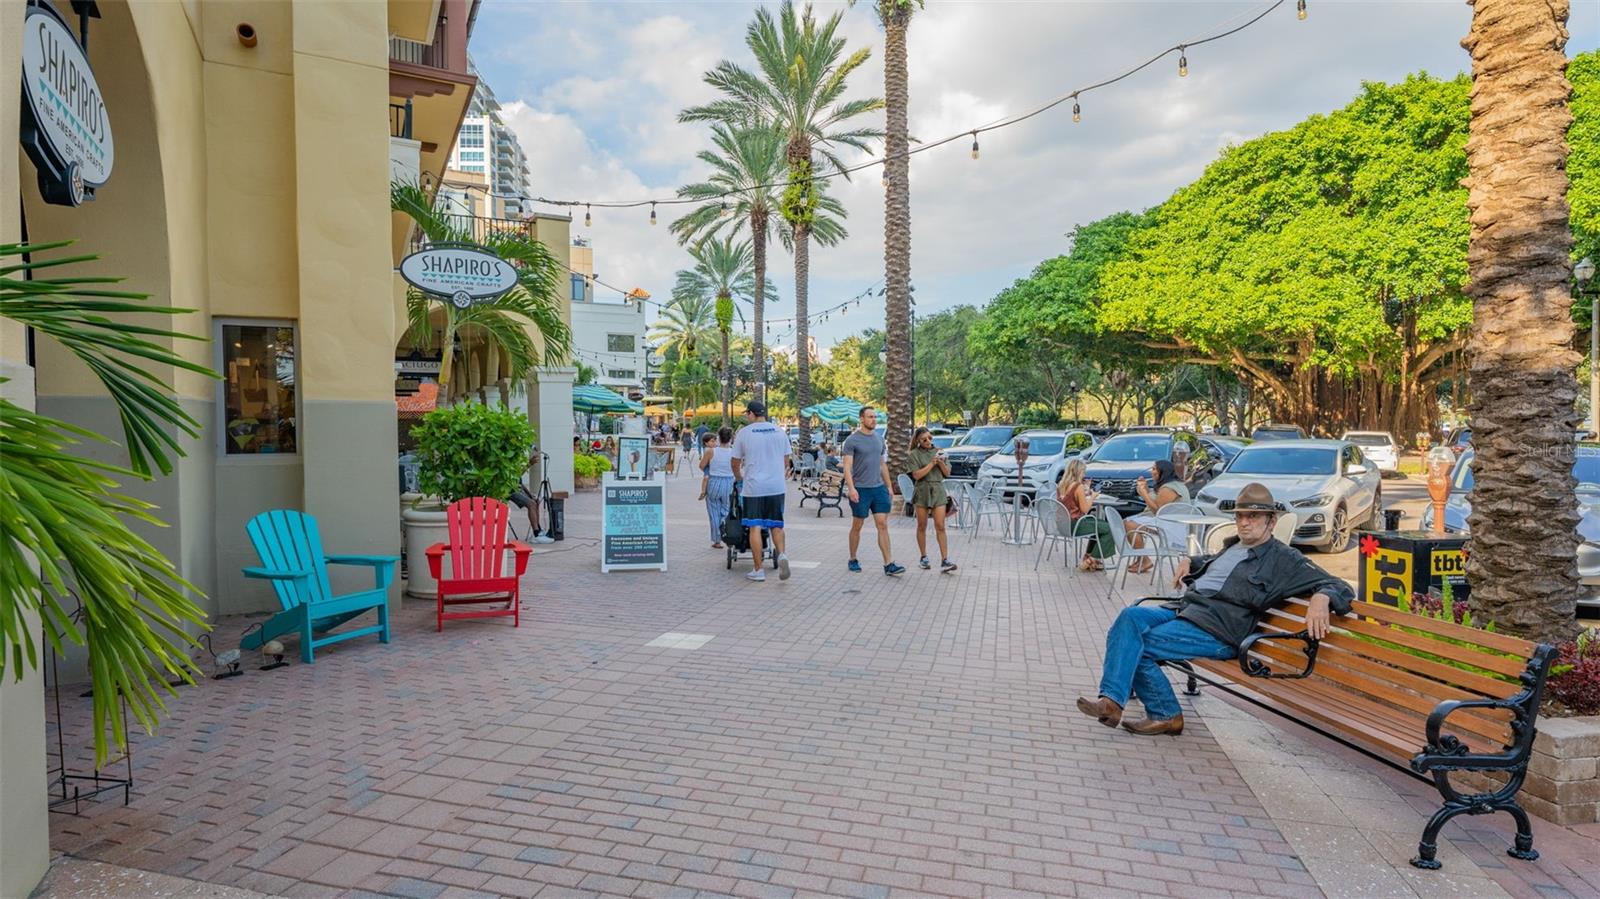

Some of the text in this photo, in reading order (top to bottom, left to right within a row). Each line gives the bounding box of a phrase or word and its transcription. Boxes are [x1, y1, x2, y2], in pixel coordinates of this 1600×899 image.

[38, 22, 104, 144] SHAPIRO'S
[39, 98, 54, 121] FINE
[56, 117, 84, 153] AMERICAN
[421, 255, 502, 278] SHAPIRO'S
[619, 489, 648, 497] SHAPIRO'S
[1373, 554, 1407, 607] bt
[1433, 554, 1463, 572] tbt
